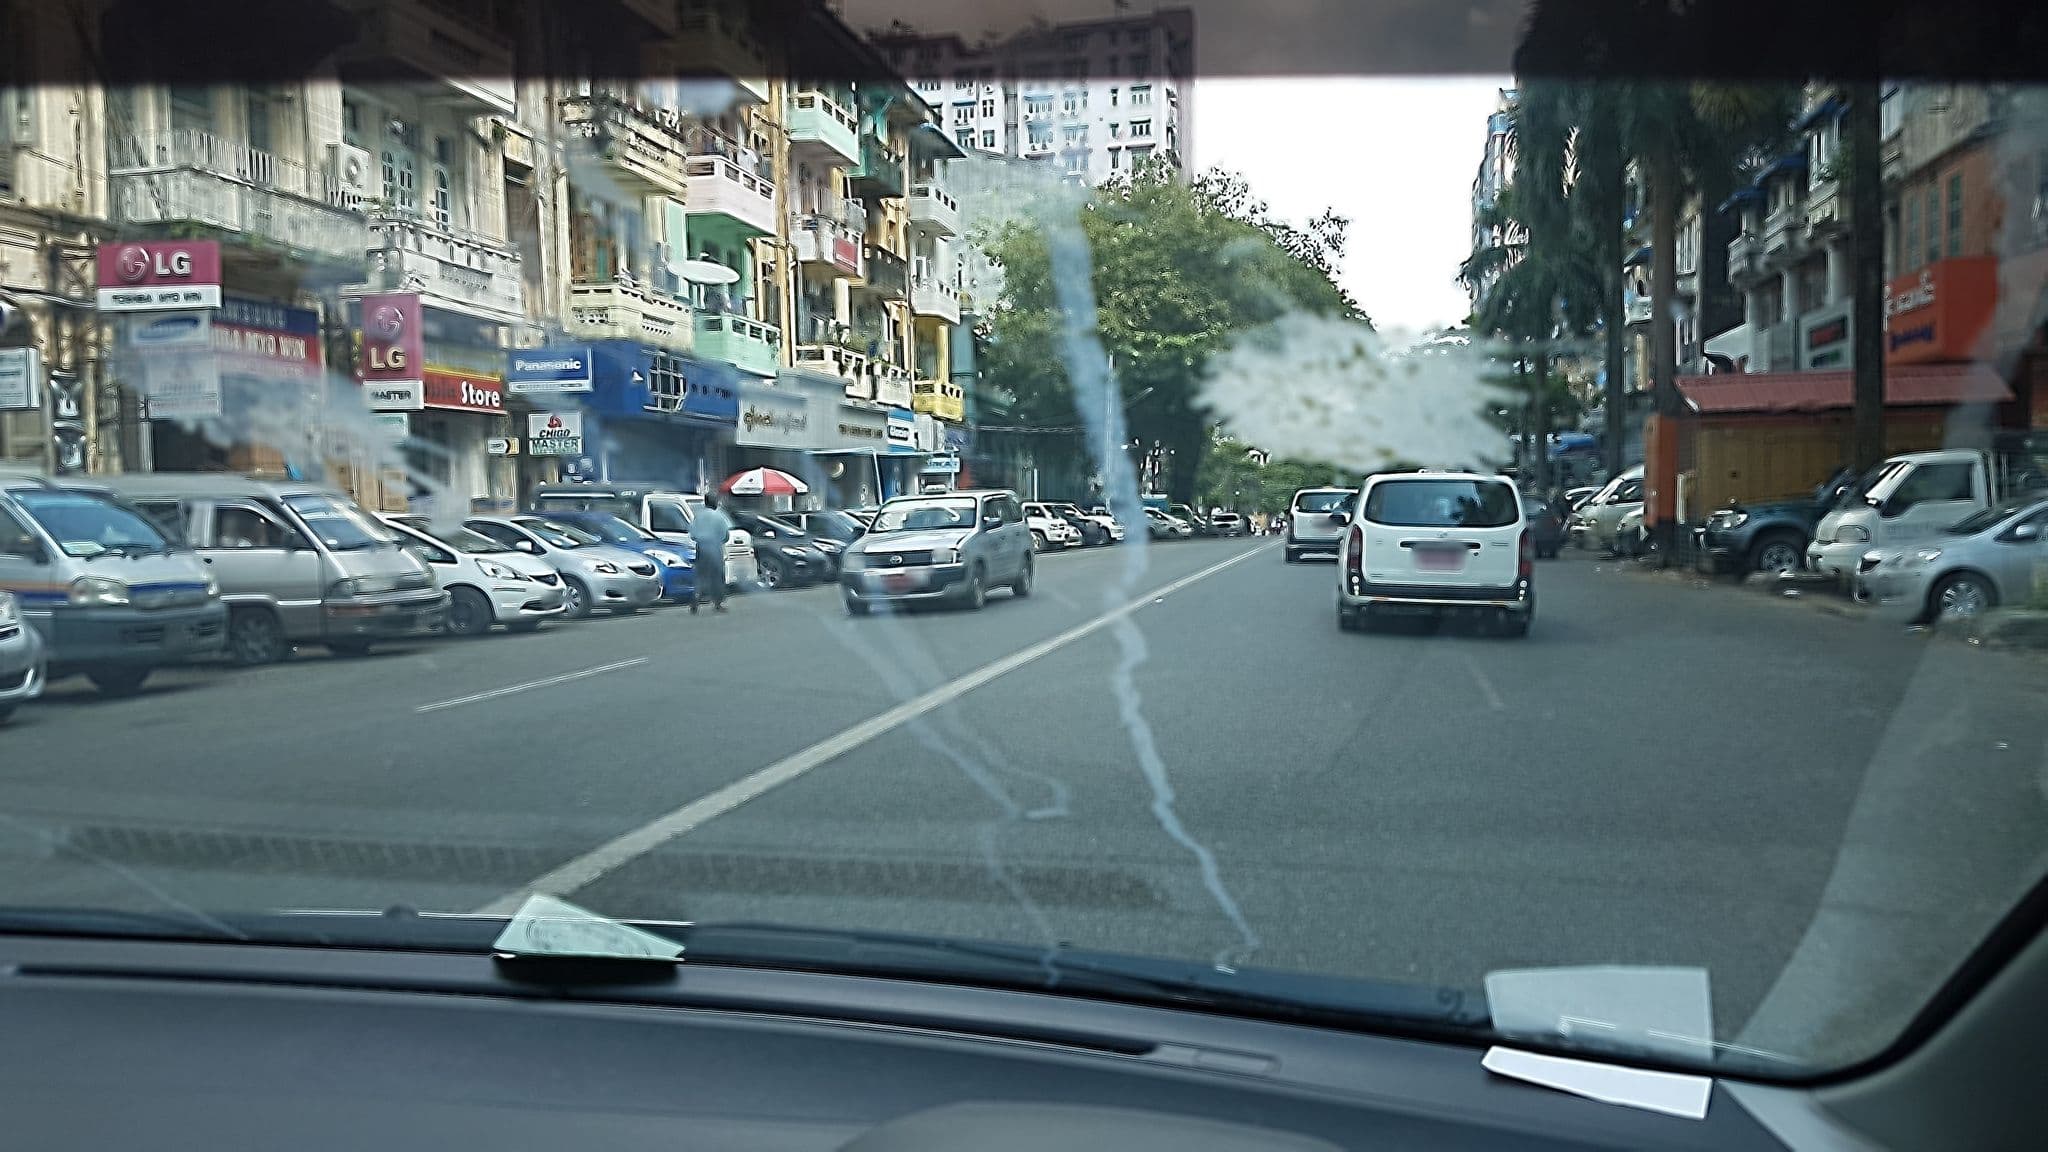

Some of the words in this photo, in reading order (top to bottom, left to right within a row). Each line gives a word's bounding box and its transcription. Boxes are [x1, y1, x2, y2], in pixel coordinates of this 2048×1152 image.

[155, 251, 192, 275] LG
[369, 346, 406, 370] LG
[515, 359, 582, 371] Panasonic
[461, 380, 500, 408] Store
[532, 439, 579, 449] MASTER
